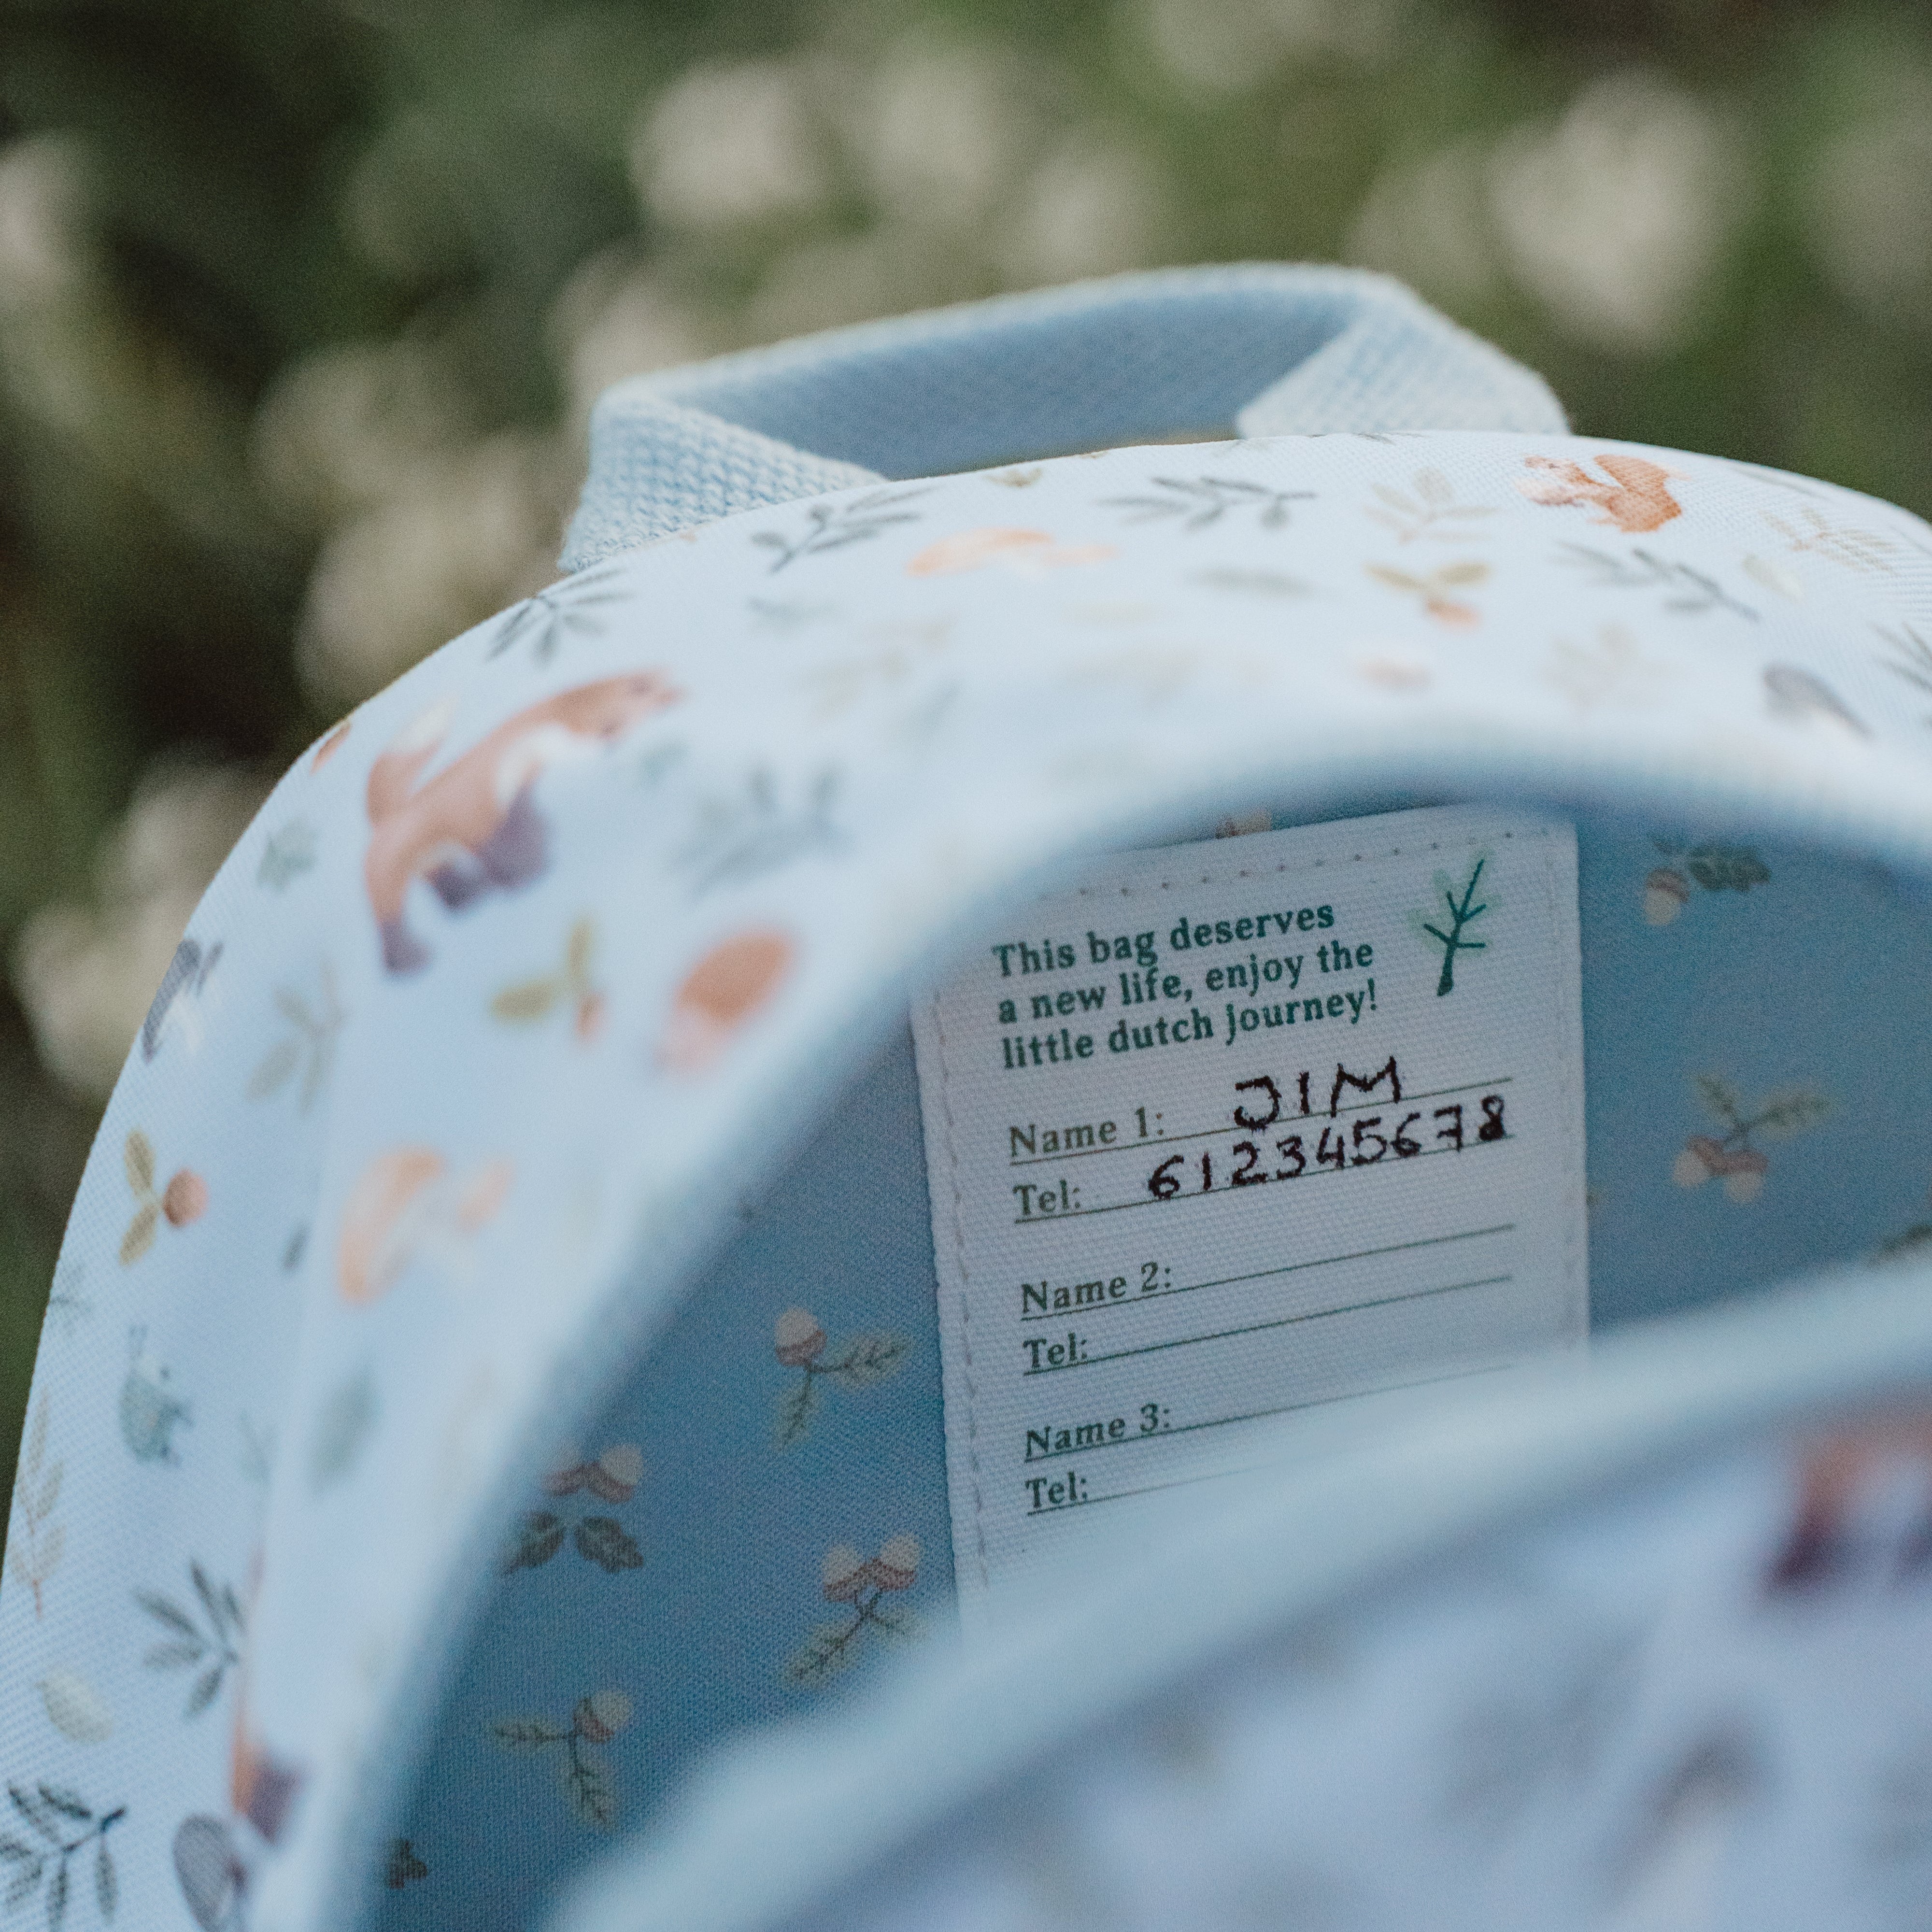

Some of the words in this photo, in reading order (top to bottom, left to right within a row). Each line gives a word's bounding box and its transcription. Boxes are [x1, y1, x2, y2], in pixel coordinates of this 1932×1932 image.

[992, 939, 1076, 978] This
[1087, 930, 1156, 967] bag
[1170, 904, 1335, 951] deserves
[998, 998, 1017, 1024] a
[1032, 984, 1107, 1020] new
[1120, 967, 1193, 1006] life,
[1205, 954, 1304, 997] enjoy
[1317, 939, 1374, 974] the
[1002, 1028, 1094, 1069] little
[1108, 1008, 1214, 1054] dutch
[1225, 978, 1378, 1046] journey!
[1234, 1056, 1402, 1131] JIM
[1010, 1119, 1117, 1158] Name
[1135, 1107, 1165, 1137] 1:
[1148, 1095, 1506, 1200] 612345678
[1013, 1180, 1081, 1217] Tel:
[1021, 1275, 1127, 1313] Name
[1140, 1261, 1172, 1293] 2:
[1023, 1333, 1088, 1371] Tel:
[1025, 1418, 1125, 1457] Name
[1140, 1404, 1171, 1433] 3:
[1025, 1471, 1088, 1509] Tel:
